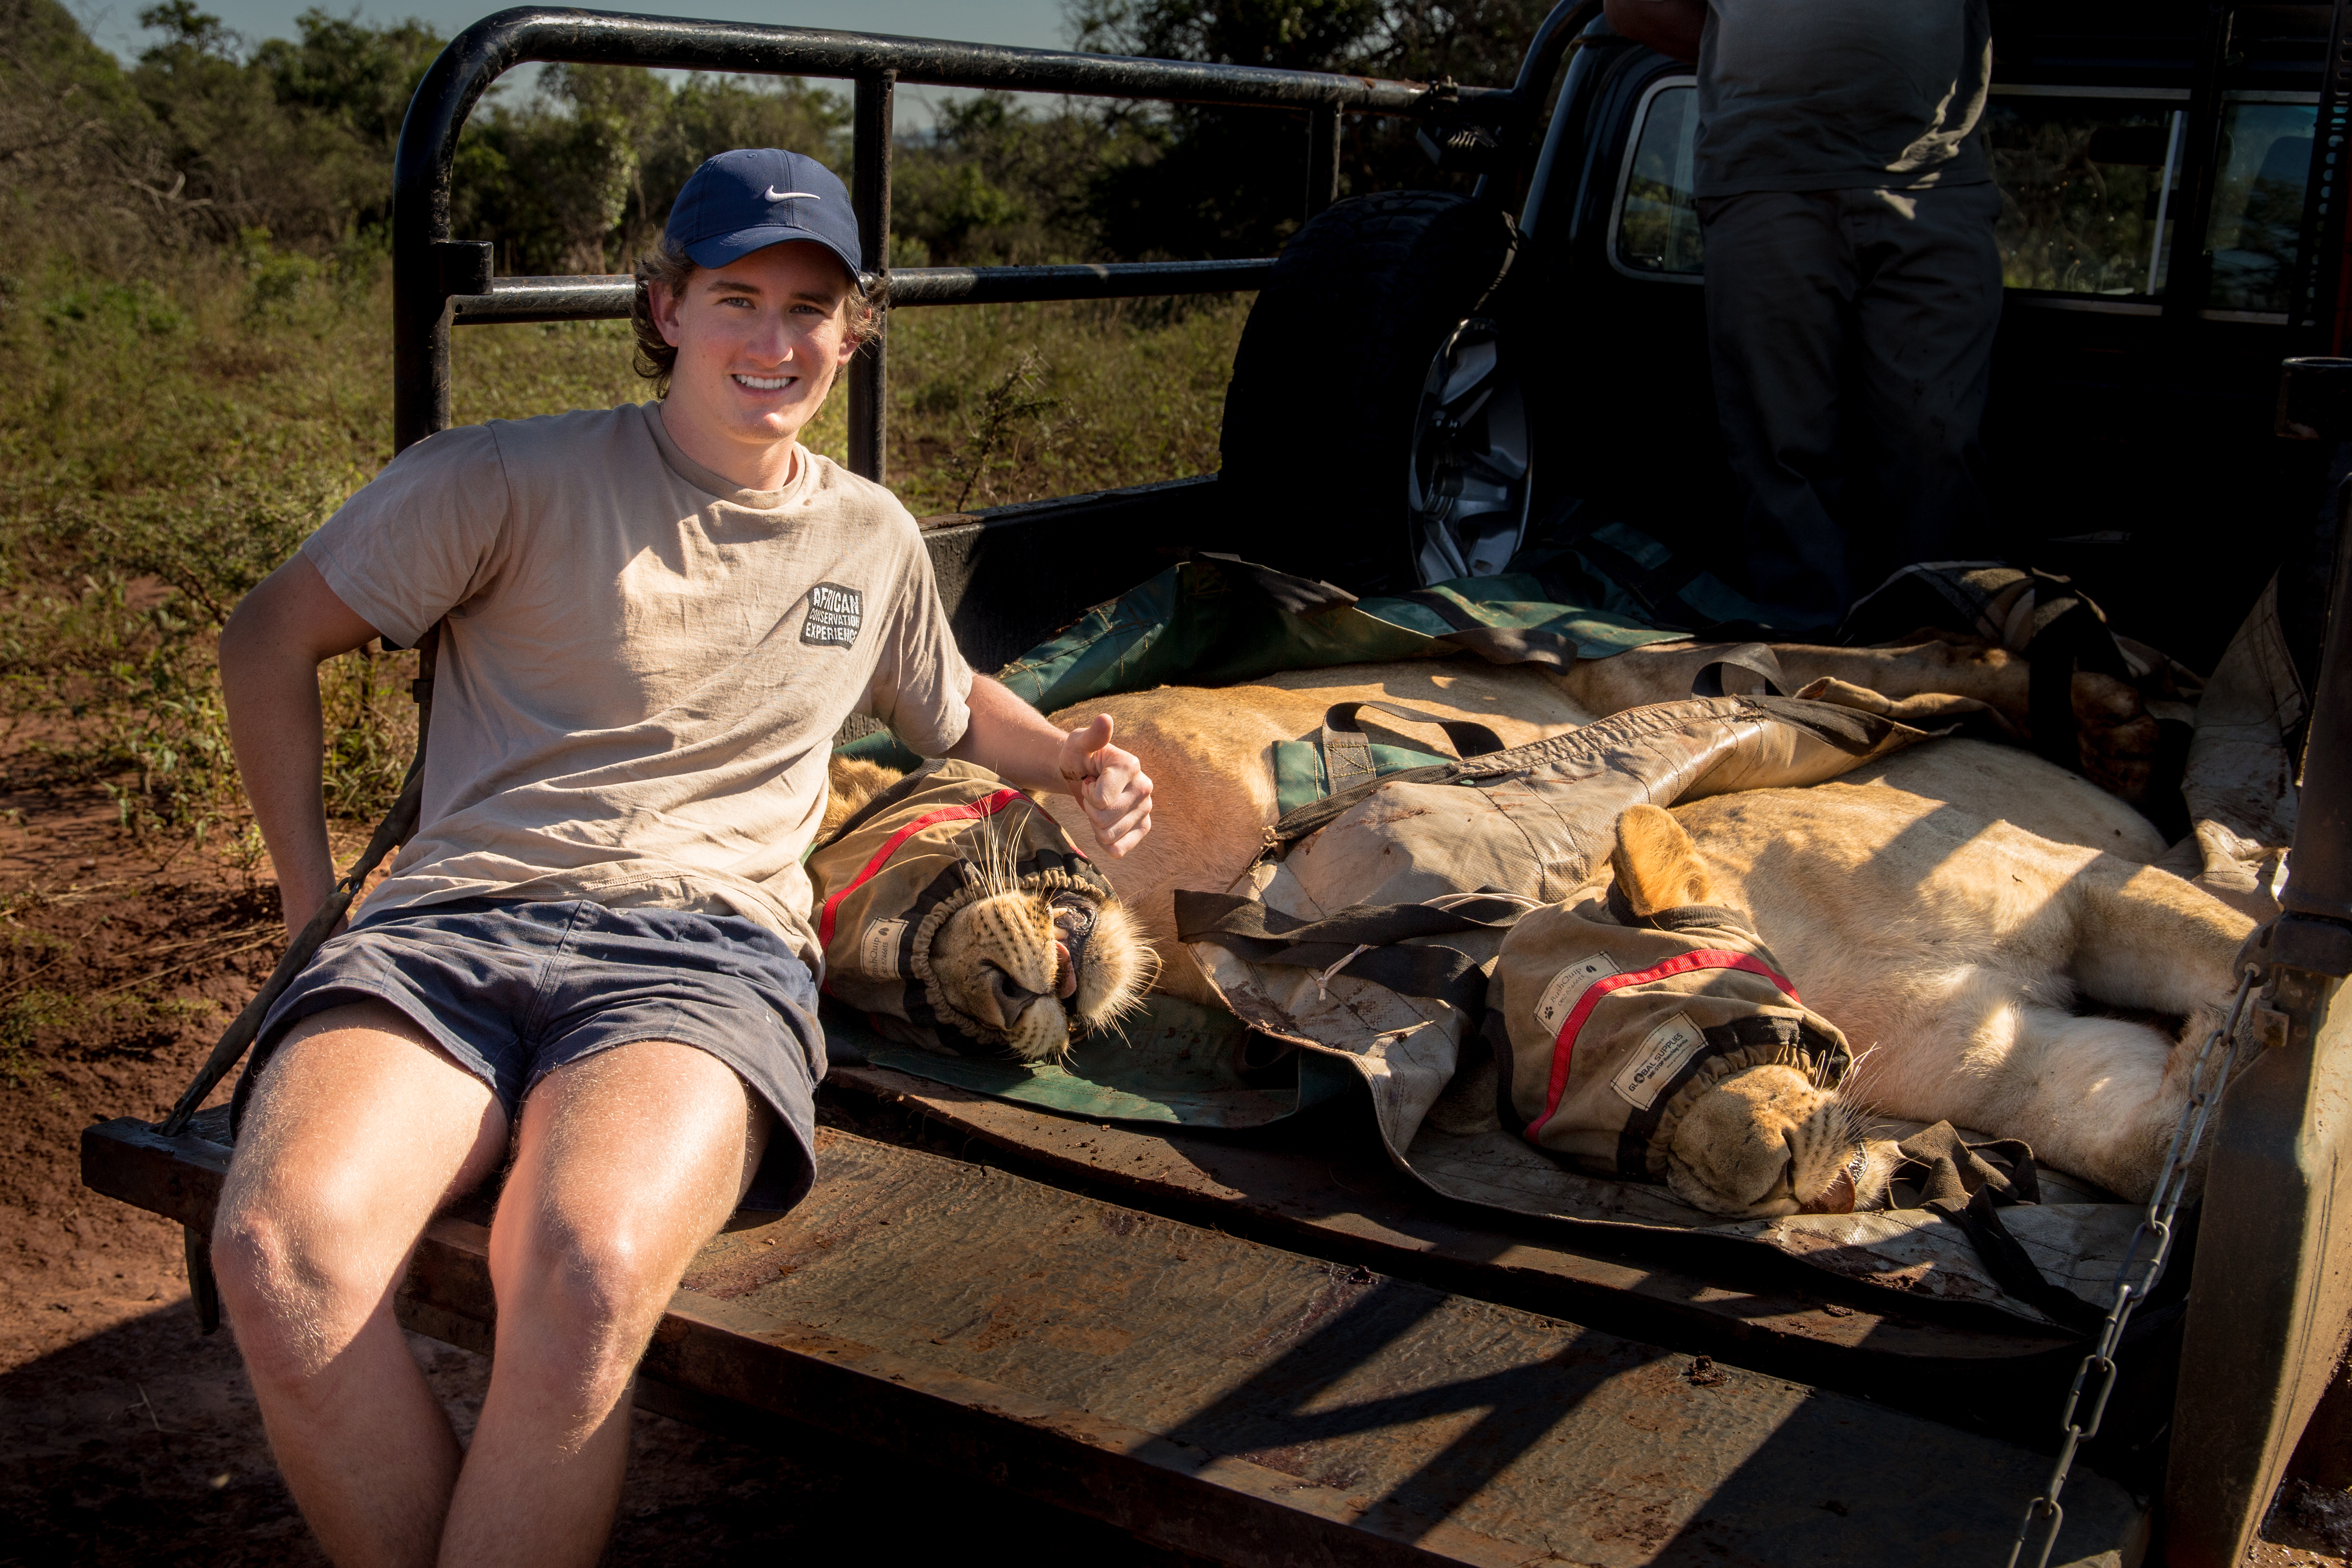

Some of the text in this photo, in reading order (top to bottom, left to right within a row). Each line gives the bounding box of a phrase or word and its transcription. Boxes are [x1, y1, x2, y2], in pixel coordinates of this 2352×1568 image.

[813, 587, 859, 615] AFRICAN
[805, 622, 857, 645] EXPERIENCE
[809, 608, 860, 629] CONSERVATION
[869, 937, 881, 976] BushQuip
[1550, 968, 1582, 1002] BushQuip
[1558, 974, 1585, 1006] 082 6746613
[1628, 1032, 1683, 1092] GLOBAL SUPPLIES
